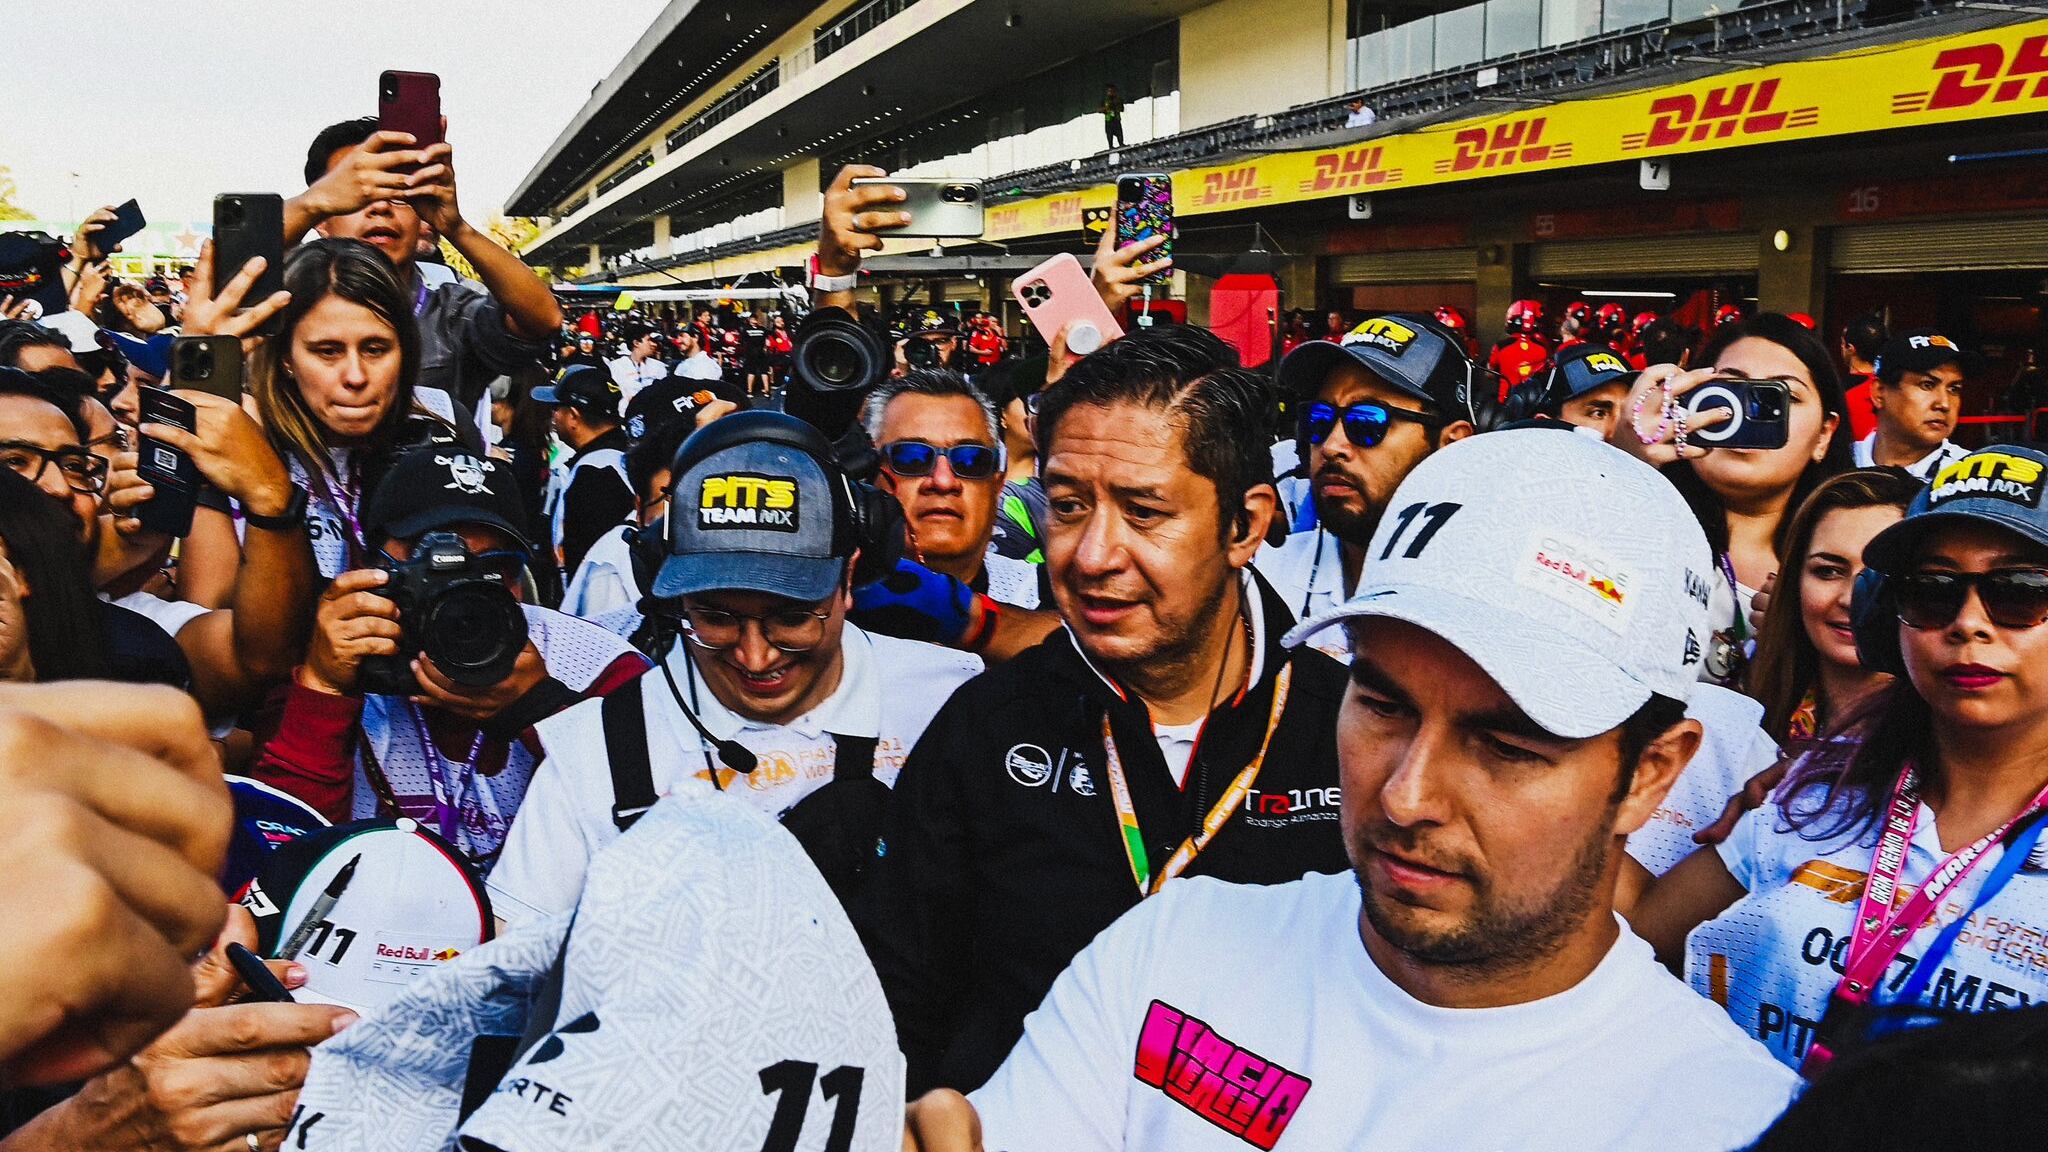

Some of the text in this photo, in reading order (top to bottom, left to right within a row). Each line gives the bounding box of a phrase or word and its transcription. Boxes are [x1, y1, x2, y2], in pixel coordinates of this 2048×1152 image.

[1927, 33, 2048, 110] DH
[1646, 78, 1789, 147] DHL
[1452, 117, 1552, 172] DHL
[1199, 167, 1262, 204] DHL
[1312, 147, 1388, 192] DHL
[1648, 161, 1662, 180] 7
[1355, 200, 1367, 213] 8
[1848, 186, 1880, 213] 16
[702, 476, 795, 508] PITS
[1991, 479, 2034, 501] MX
[700, 507, 794, 527] TEAM MX
[1379, 501, 1464, 561] 11
[432, 553, 466, 564] Canon
[1535, 551, 1588, 583] Red Bull
[1888, 815, 1909, 833] DE
[1895, 799, 1914, 817] LA
[1877, 832, 1905, 876] PREMIO
[1869, 872, 1895, 905] GRAN
[304, 919, 358, 968] 11
[376, 943, 430, 961] Red Bull
[506, 1077, 573, 1117] RTE
[758, 1060, 866, 1152] 11
